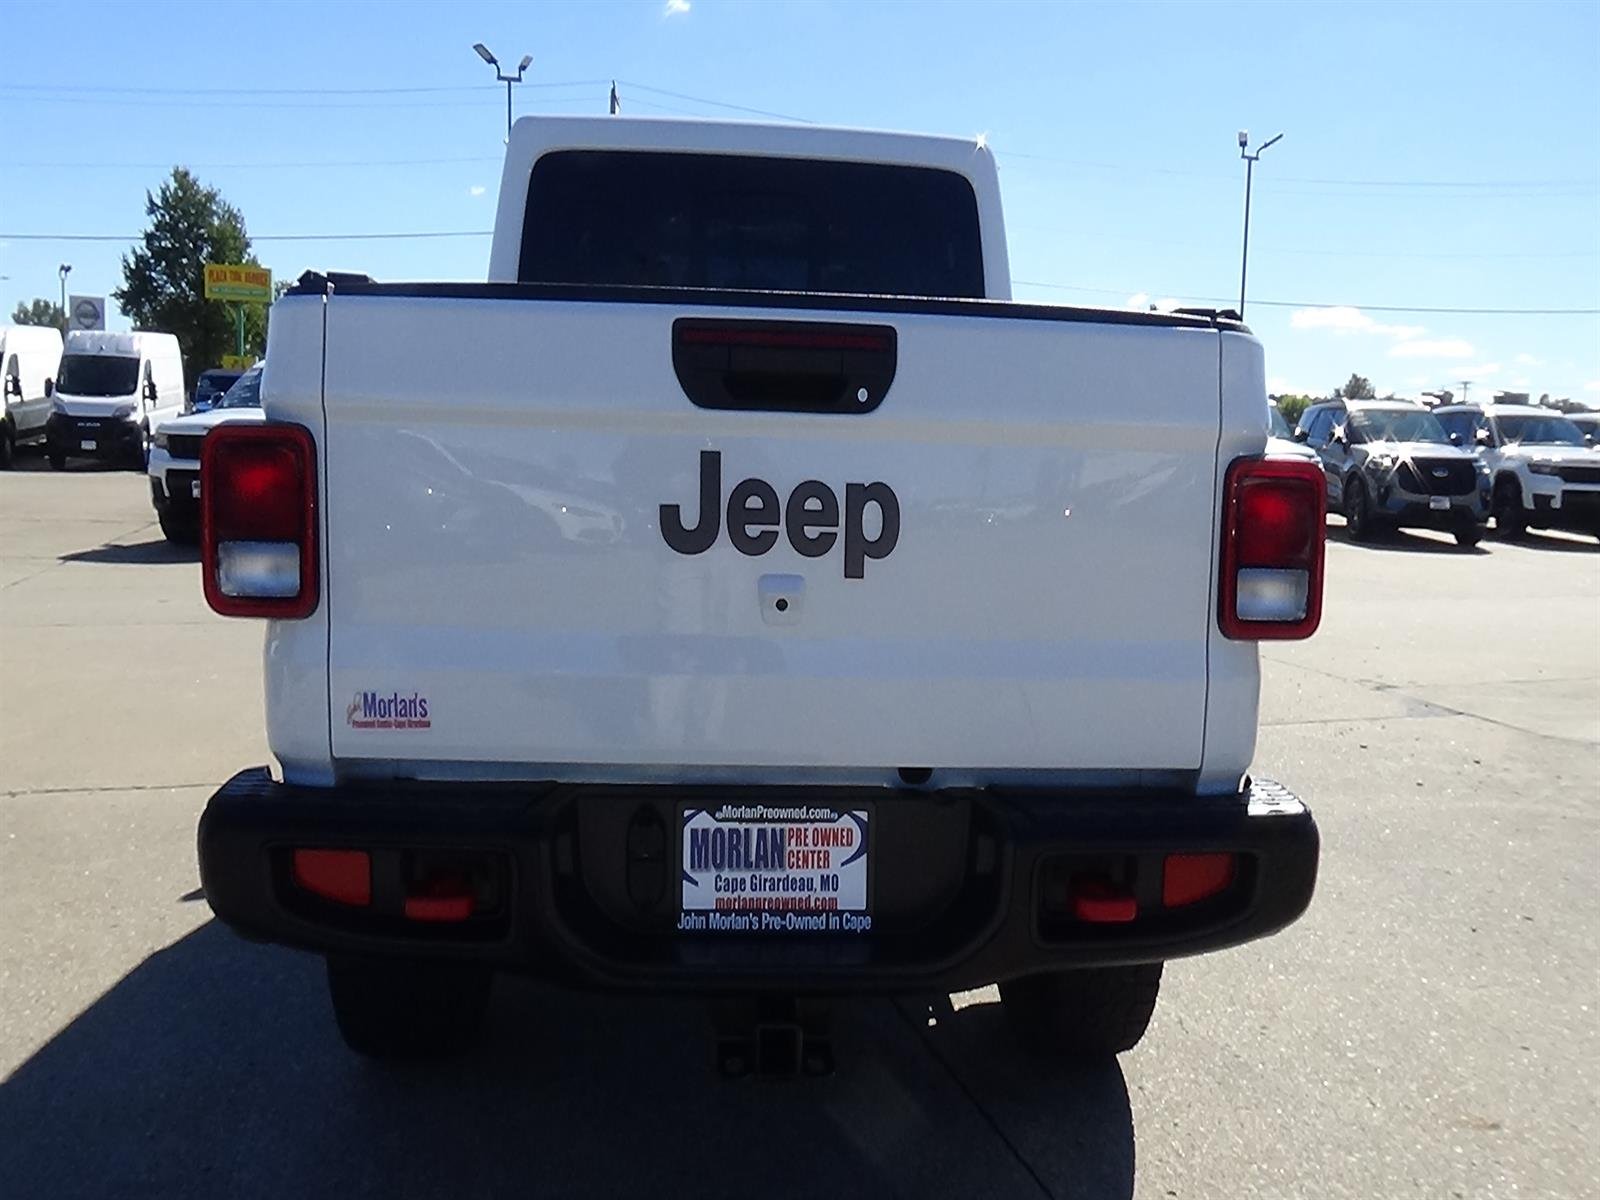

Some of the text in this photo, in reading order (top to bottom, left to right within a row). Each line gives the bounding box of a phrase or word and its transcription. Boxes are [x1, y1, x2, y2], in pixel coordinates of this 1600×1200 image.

[659, 450, 900, 579] Jeep
[363, 692, 428, 718] Morlan's
[722, 805, 831, 820] MorlanPreowned.com
[787, 827, 854, 847] PRE OWNED
[690, 828, 784, 870] MORLAN
[787, 850, 830, 869] CENTER
[714, 874, 839, 894] Cape Girardeau, MO
[677, 912, 706, 930] John
[709, 912, 759, 930] Morlan's
[762, 913, 826, 930] Pre-Owned
[843, 913, 872, 933] Cape
